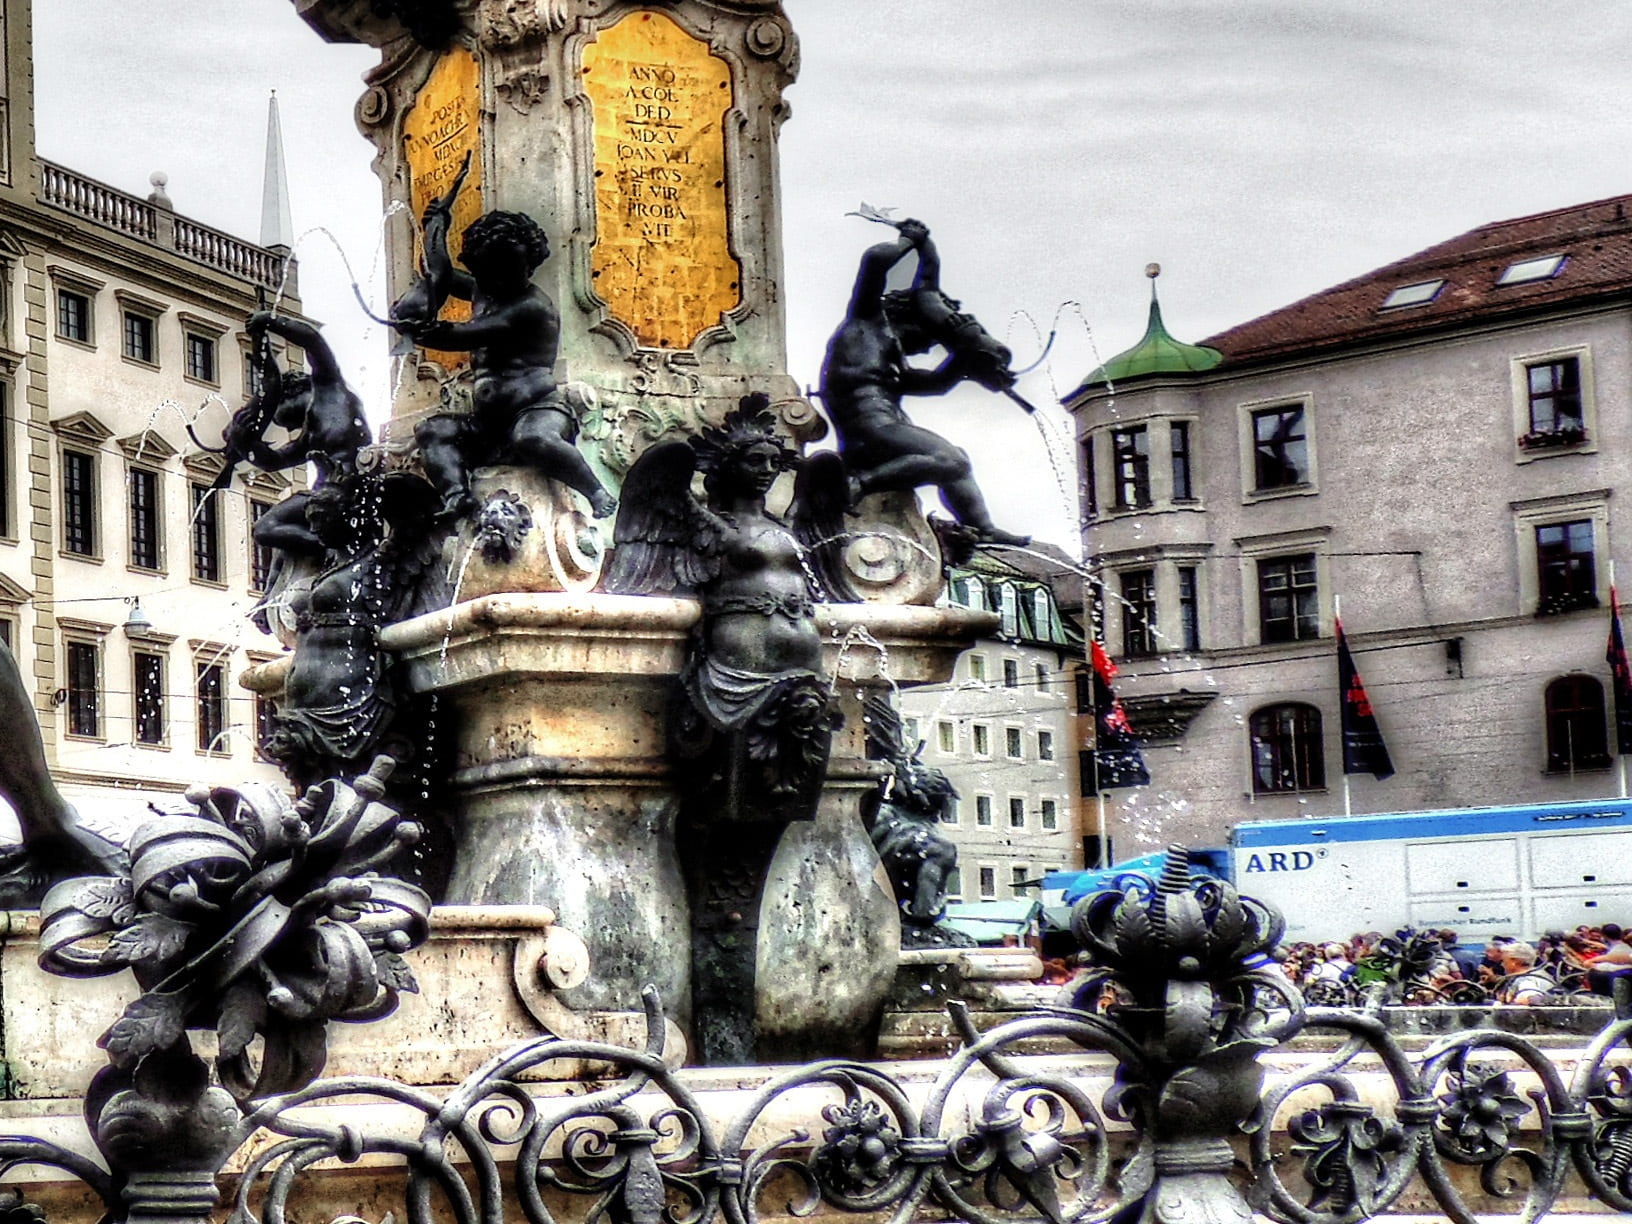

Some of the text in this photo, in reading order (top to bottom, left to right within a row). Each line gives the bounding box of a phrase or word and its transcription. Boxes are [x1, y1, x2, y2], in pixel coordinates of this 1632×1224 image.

[629, 67, 676, 84] ANNO
[635, 103, 671, 121] DED
[649, 185, 679, 201] VIR
[627, 201, 688, 220] PROBA
[1245, 850, 1316, 873] ARD
